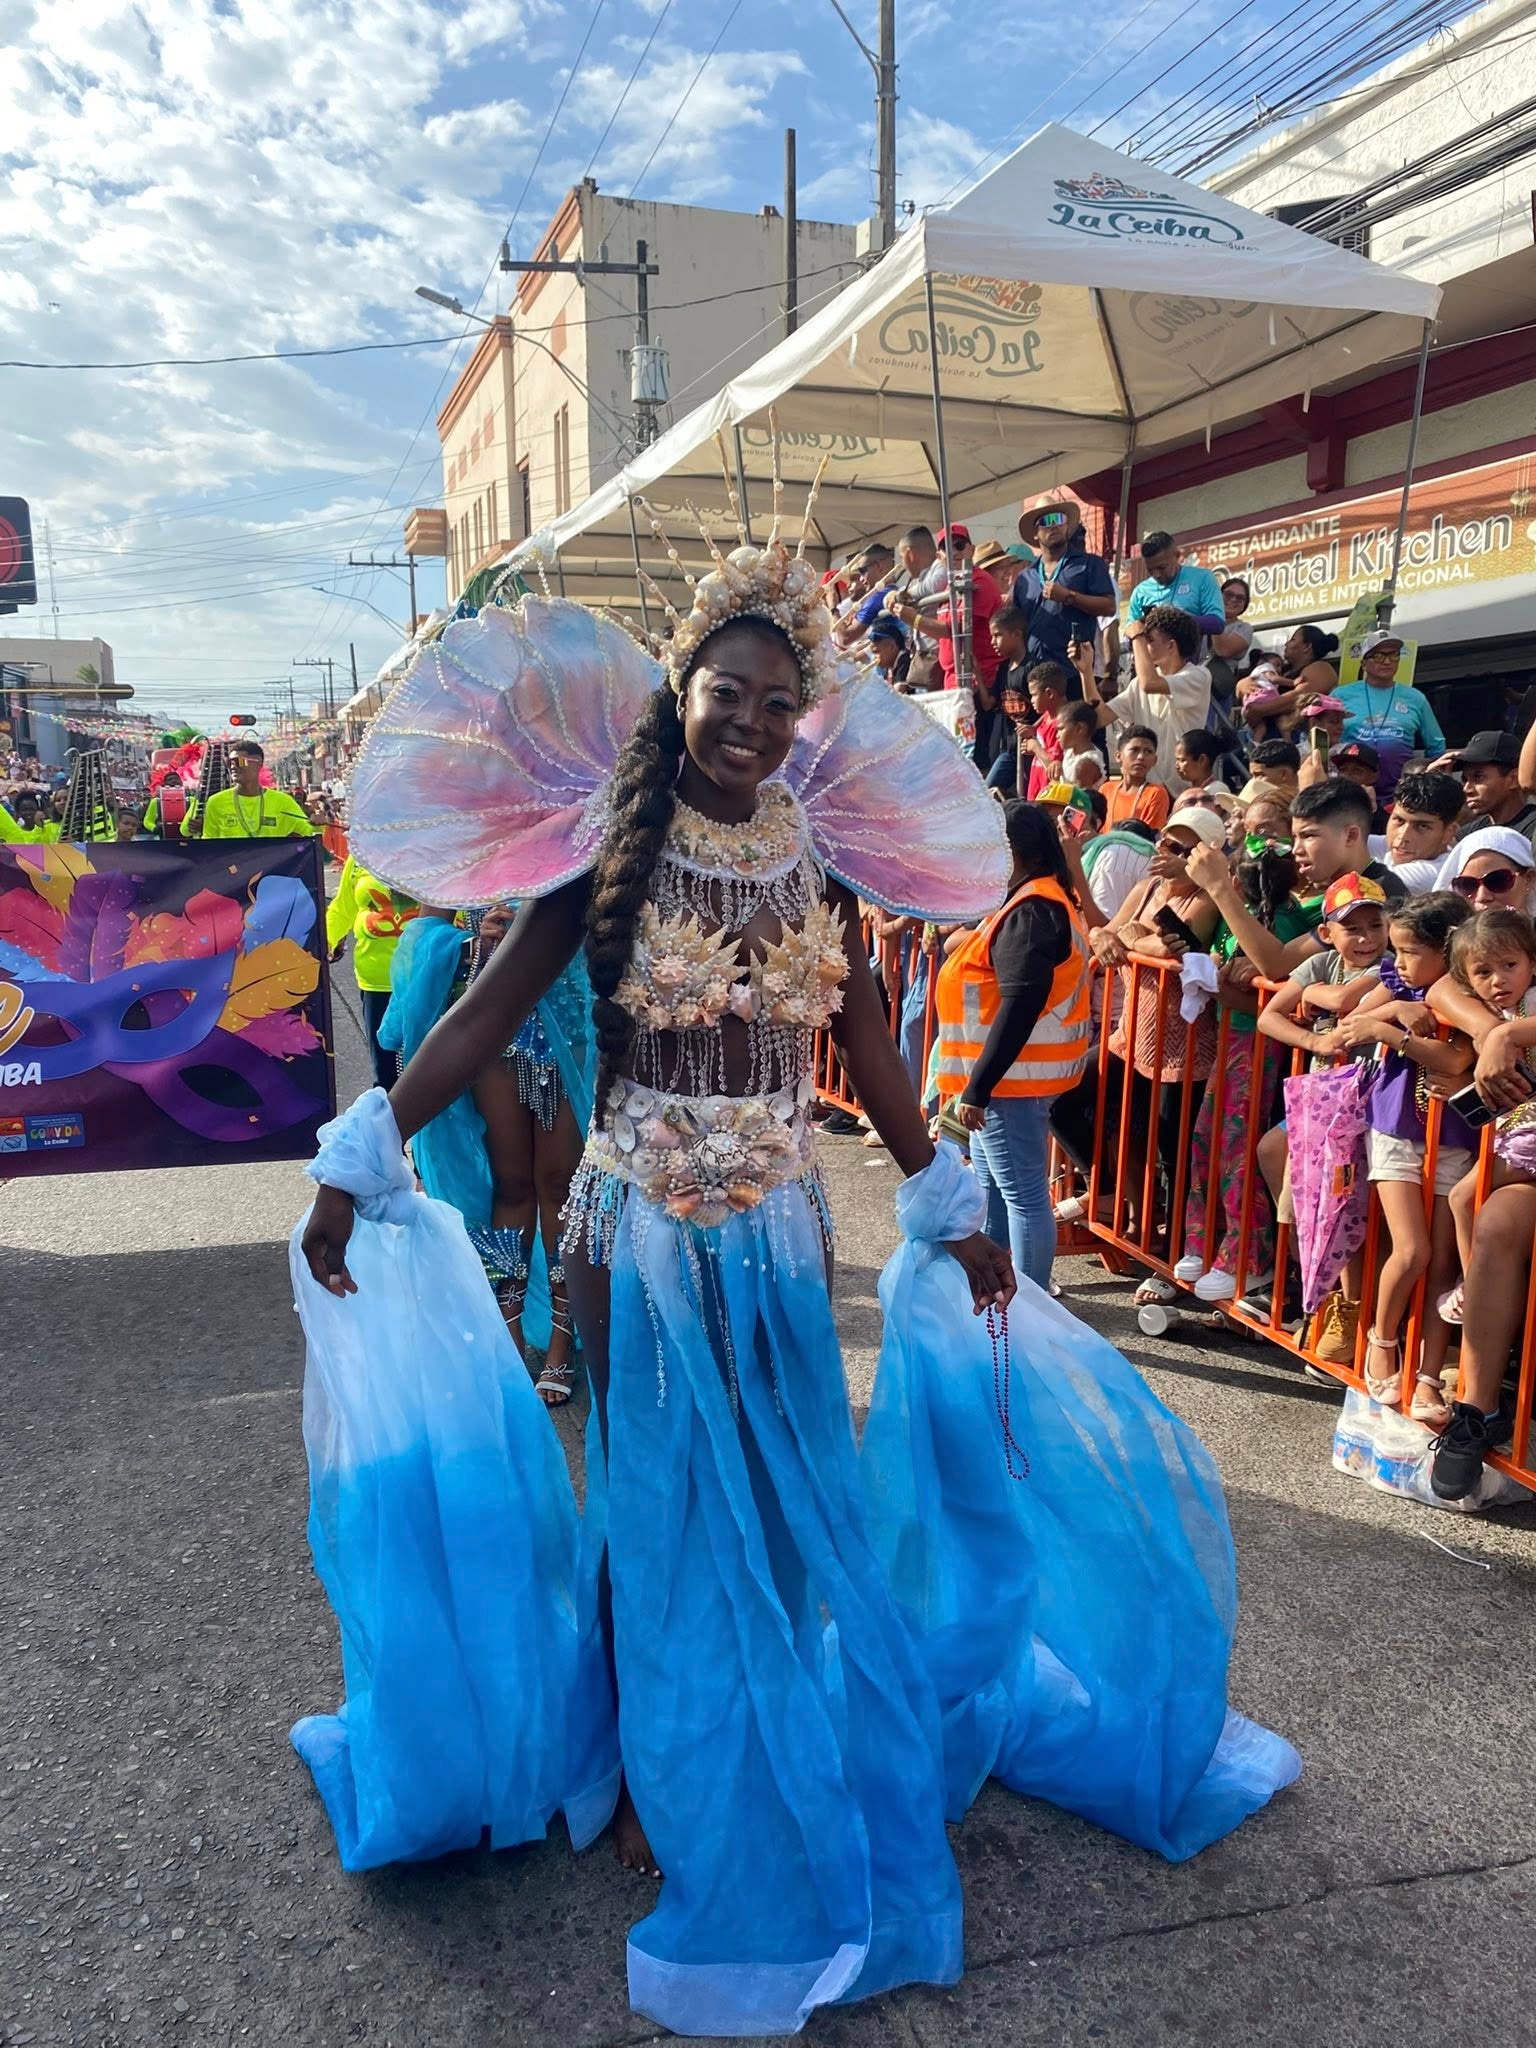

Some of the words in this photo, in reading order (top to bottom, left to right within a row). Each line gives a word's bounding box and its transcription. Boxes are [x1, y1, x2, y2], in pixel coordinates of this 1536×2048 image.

[1048, 204, 1104, 237] La
[1108, 212, 1224, 243] Ceiba
[1207, 514, 1341, 563] RESTAURANTE
[1269, 592, 1315, 612] CHINA
[1319, 588, 1329, 603] E
